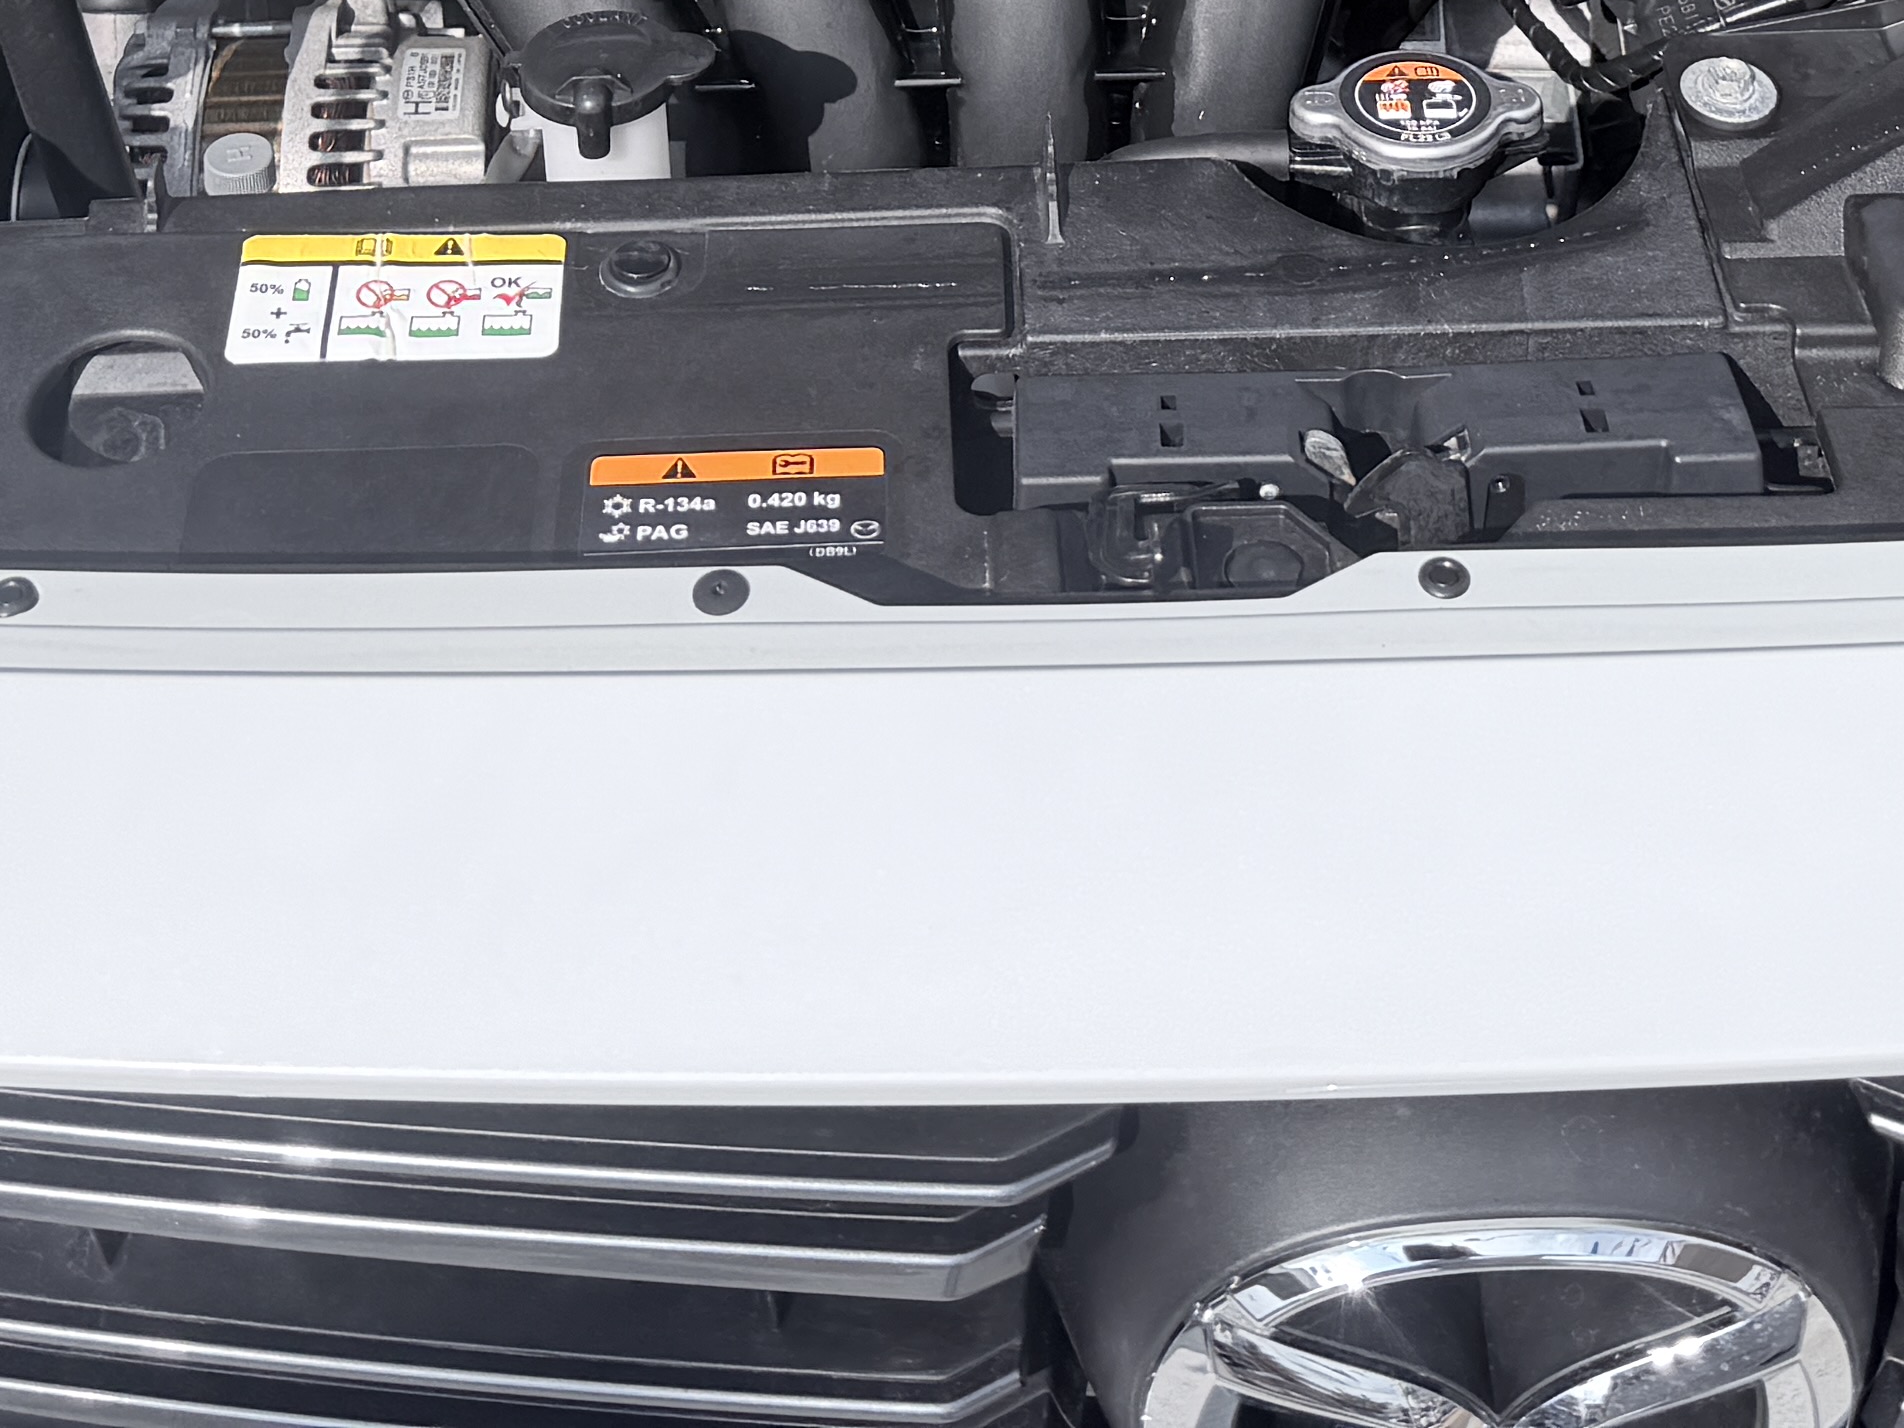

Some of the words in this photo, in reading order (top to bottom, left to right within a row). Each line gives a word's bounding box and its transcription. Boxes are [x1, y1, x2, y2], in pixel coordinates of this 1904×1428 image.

[249, 282, 284, 295] 50%
[490, 276, 522, 289] OK
[241, 328, 277, 339] 50%
[638, 496, 716, 513] R-134a
[747, 492, 807, 508] 0.420
[813, 491, 841, 509] kg
[636, 524, 689, 541] PAG
[746, 521, 790, 535] SAE
[793, 519, 841, 534] J639
